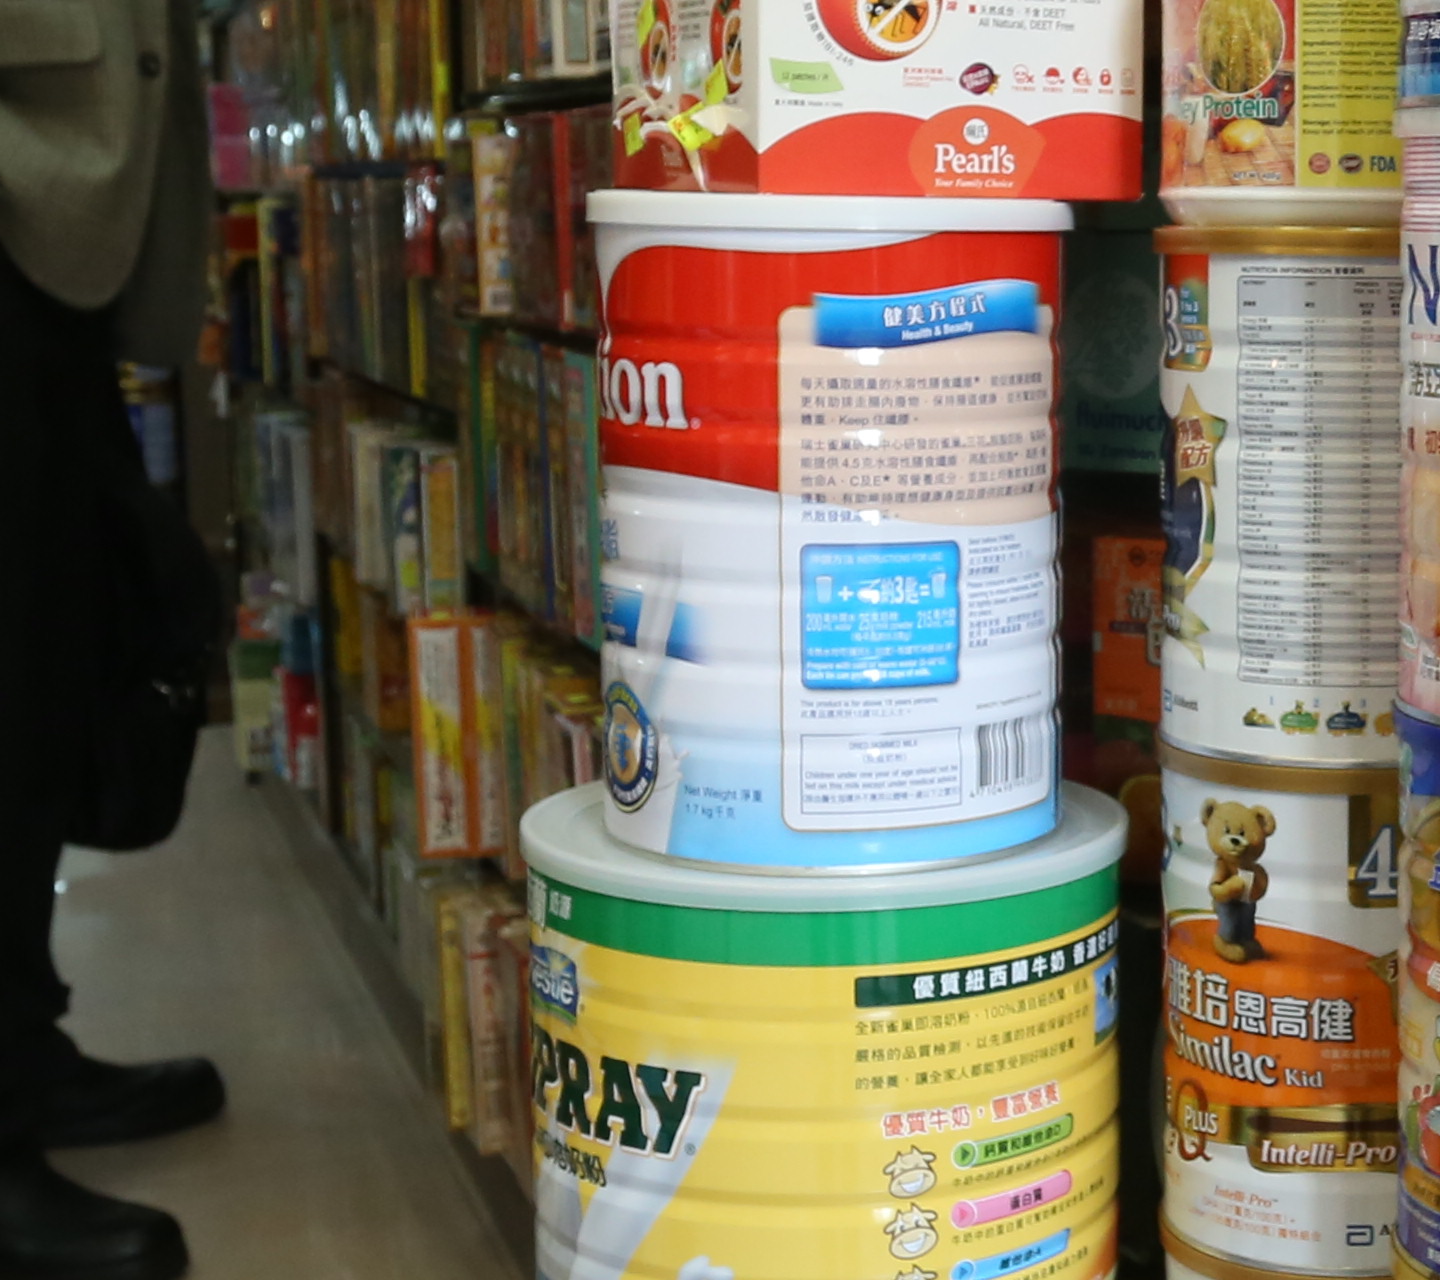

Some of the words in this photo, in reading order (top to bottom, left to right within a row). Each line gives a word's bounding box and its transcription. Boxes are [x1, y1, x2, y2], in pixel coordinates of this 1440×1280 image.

[1202, 94, 1278, 119] Protein
[935, 143, 1016, 175] Pearl's
[883, 292, 987, 328] 健美方程式
[1359, 843, 1397, 900] 4
[913, 951, 1066, 1000] 優質紐西蘭牛奶
[1169, 1008, 1280, 1088] Similac
[1285, 1068, 1323, 1090] Kid
[1259, 1139, 1397, 1168] Intelli-Pro
